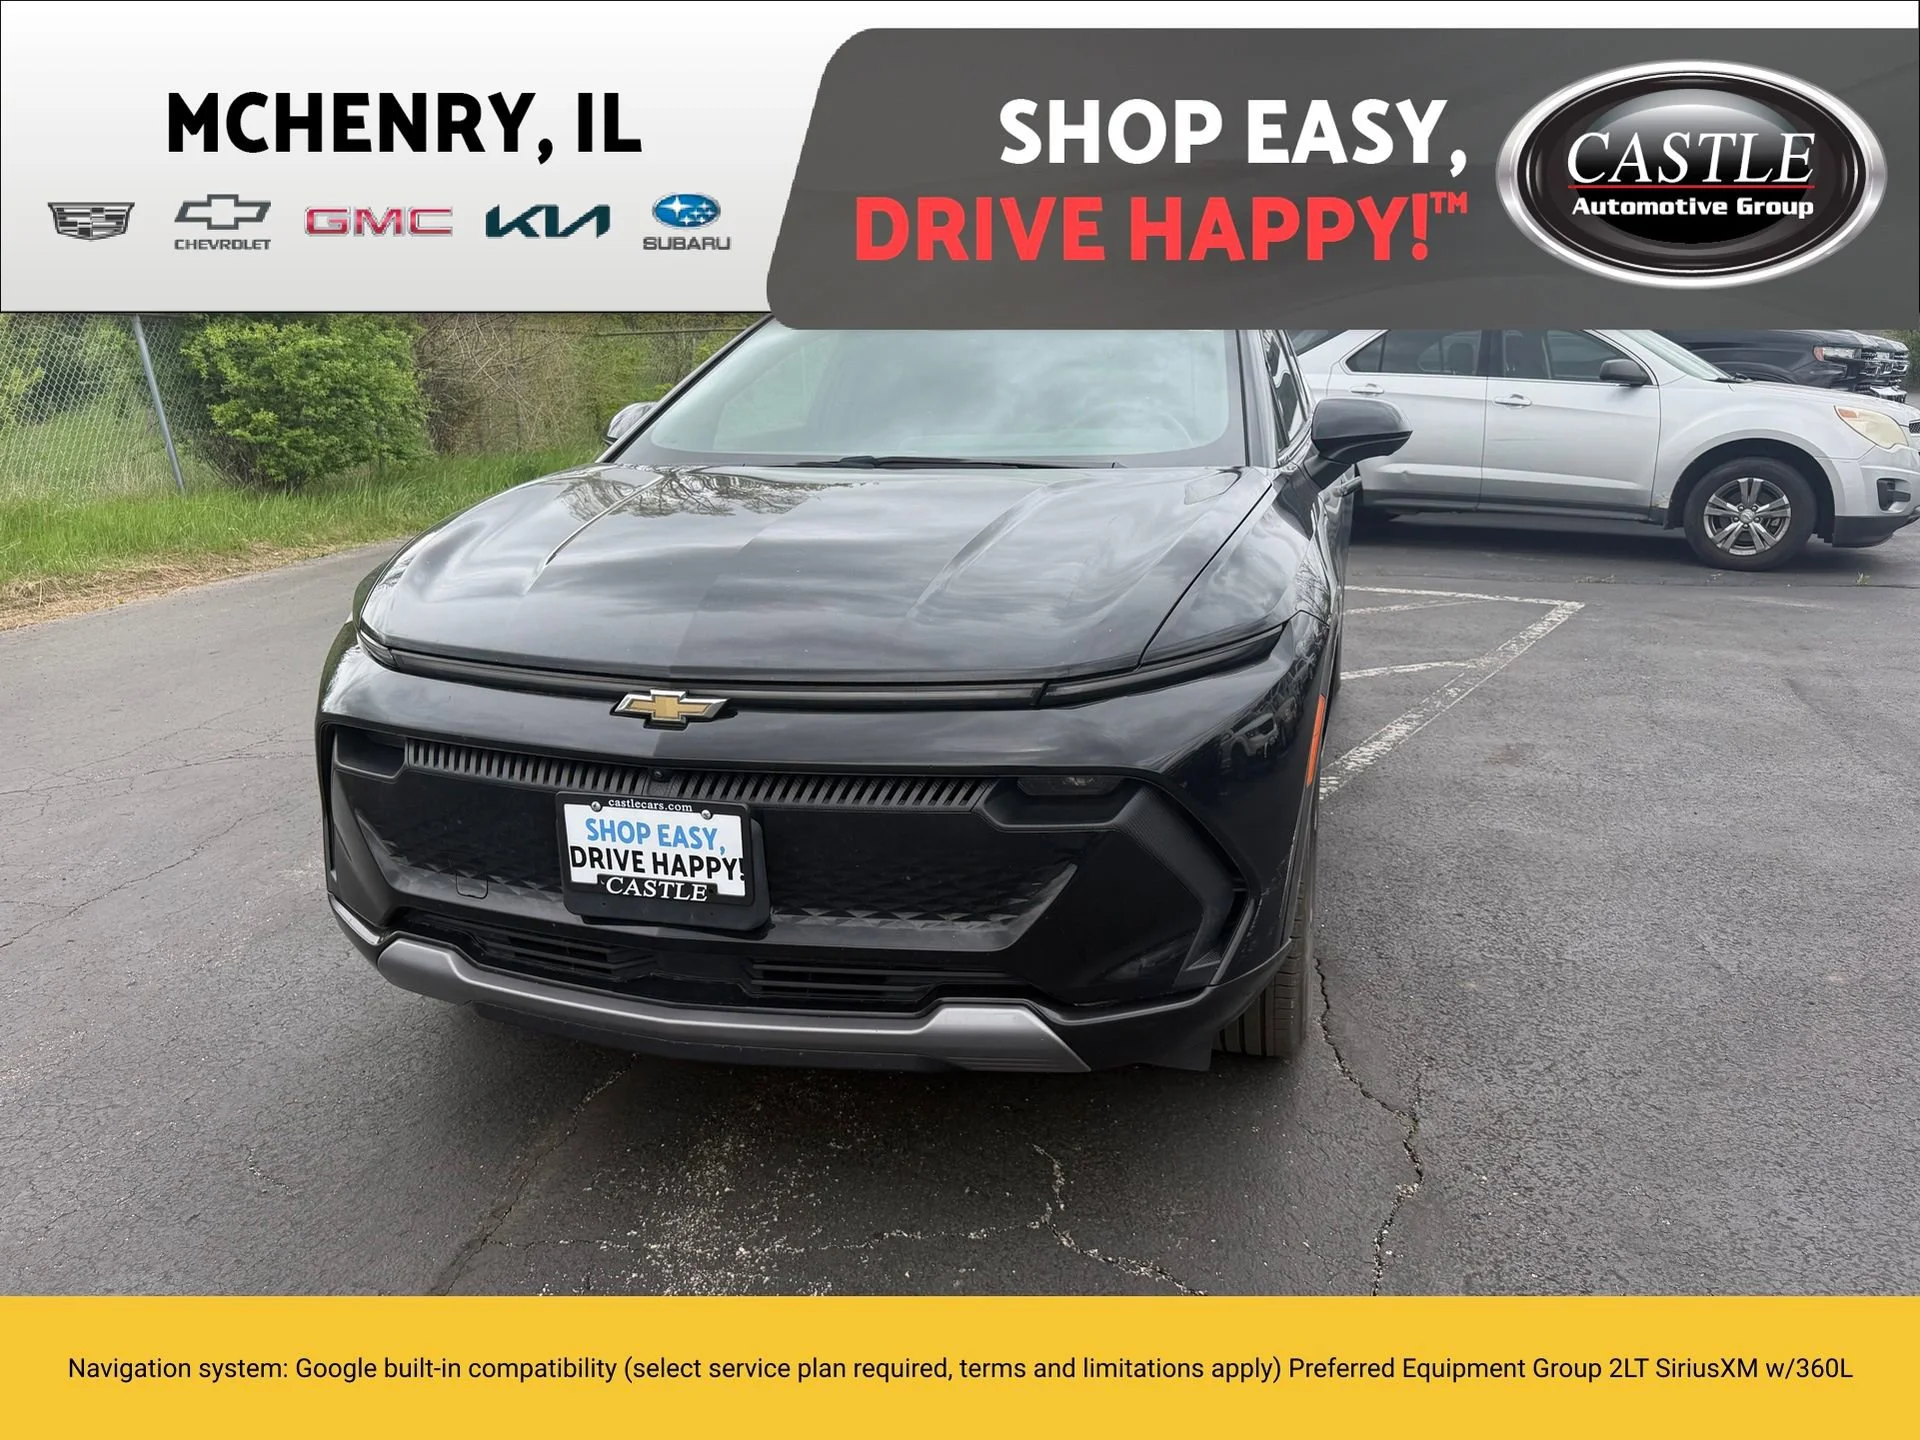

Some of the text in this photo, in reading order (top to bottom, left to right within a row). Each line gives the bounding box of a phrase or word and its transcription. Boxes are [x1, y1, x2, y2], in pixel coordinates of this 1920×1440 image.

[608, 799, 693, 812] castlecars.com
[585, 817, 726, 856] SHOP EASY,
[570, 845, 745, 881] DRIVE HAPPY!
[606, 876, 708, 901] CASTLE
